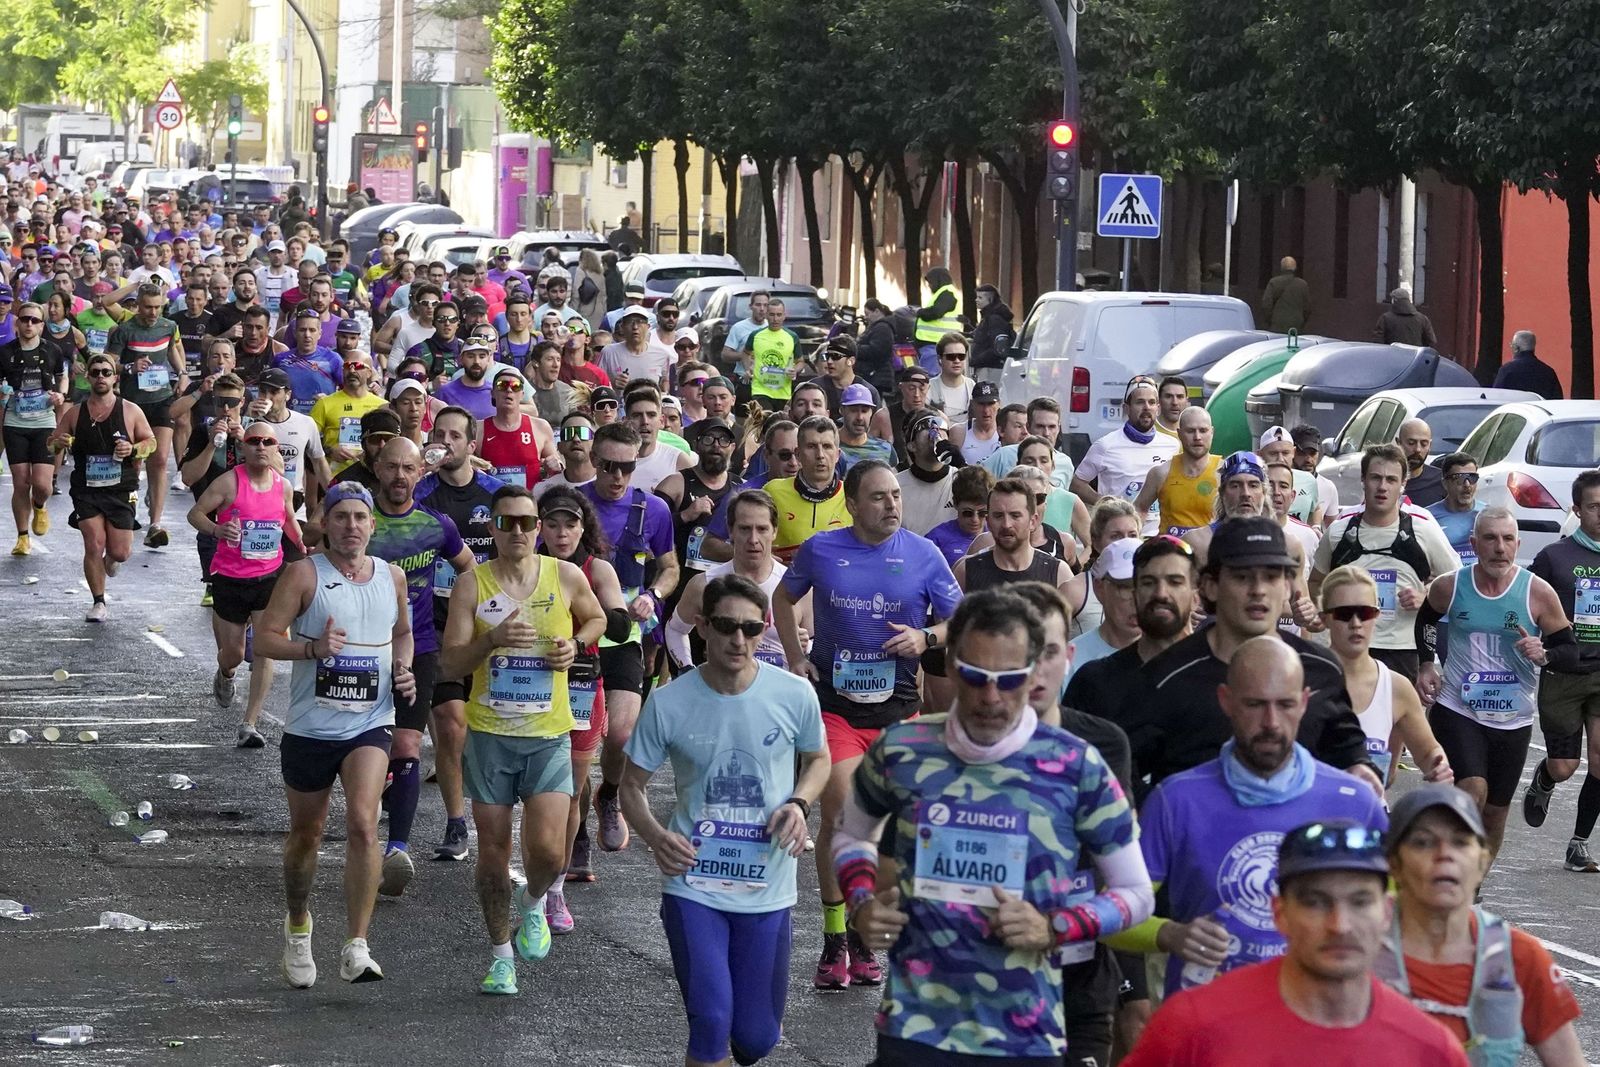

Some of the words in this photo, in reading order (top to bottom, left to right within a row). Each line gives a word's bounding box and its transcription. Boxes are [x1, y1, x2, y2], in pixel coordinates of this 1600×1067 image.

[161, 112, 178, 122] 30
[1109, 407, 1121, 418] 91
[250, 541, 274, 551] OSCAR
[755, 655, 777, 664] RICH
[854, 651, 888, 661] ZURICH
[339, 659, 373, 668] ZURICH
[512, 659, 546, 669] ZURICH
[855, 668, 874, 676] 7018
[338, 676, 358, 685] 5198
[512, 676, 532, 685] 8882
[841, 676, 887, 691] JKNUÑO
[1483, 674, 1515, 682] ZURICH
[569, 681, 592, 689] URICH
[326, 685, 368, 700] JUANJI
[516, 690, 552, 702] GONZÁLEZ
[1483, 689, 1501, 697] 9047
[1469, 699, 1513, 710] PATRICK
[702, 807, 767, 823] SEVILLA
[956, 811, 1017, 829] ZURICH
[720, 826, 763, 838] ZURICH
[719, 847, 742, 858] 8861
[955, 840, 988, 855] 8186
[691, 859, 766, 880] PEDRULEZ
[932, 852, 1007, 884] ÁLVARO
[1246, 942, 1289, 957] ZURIC
